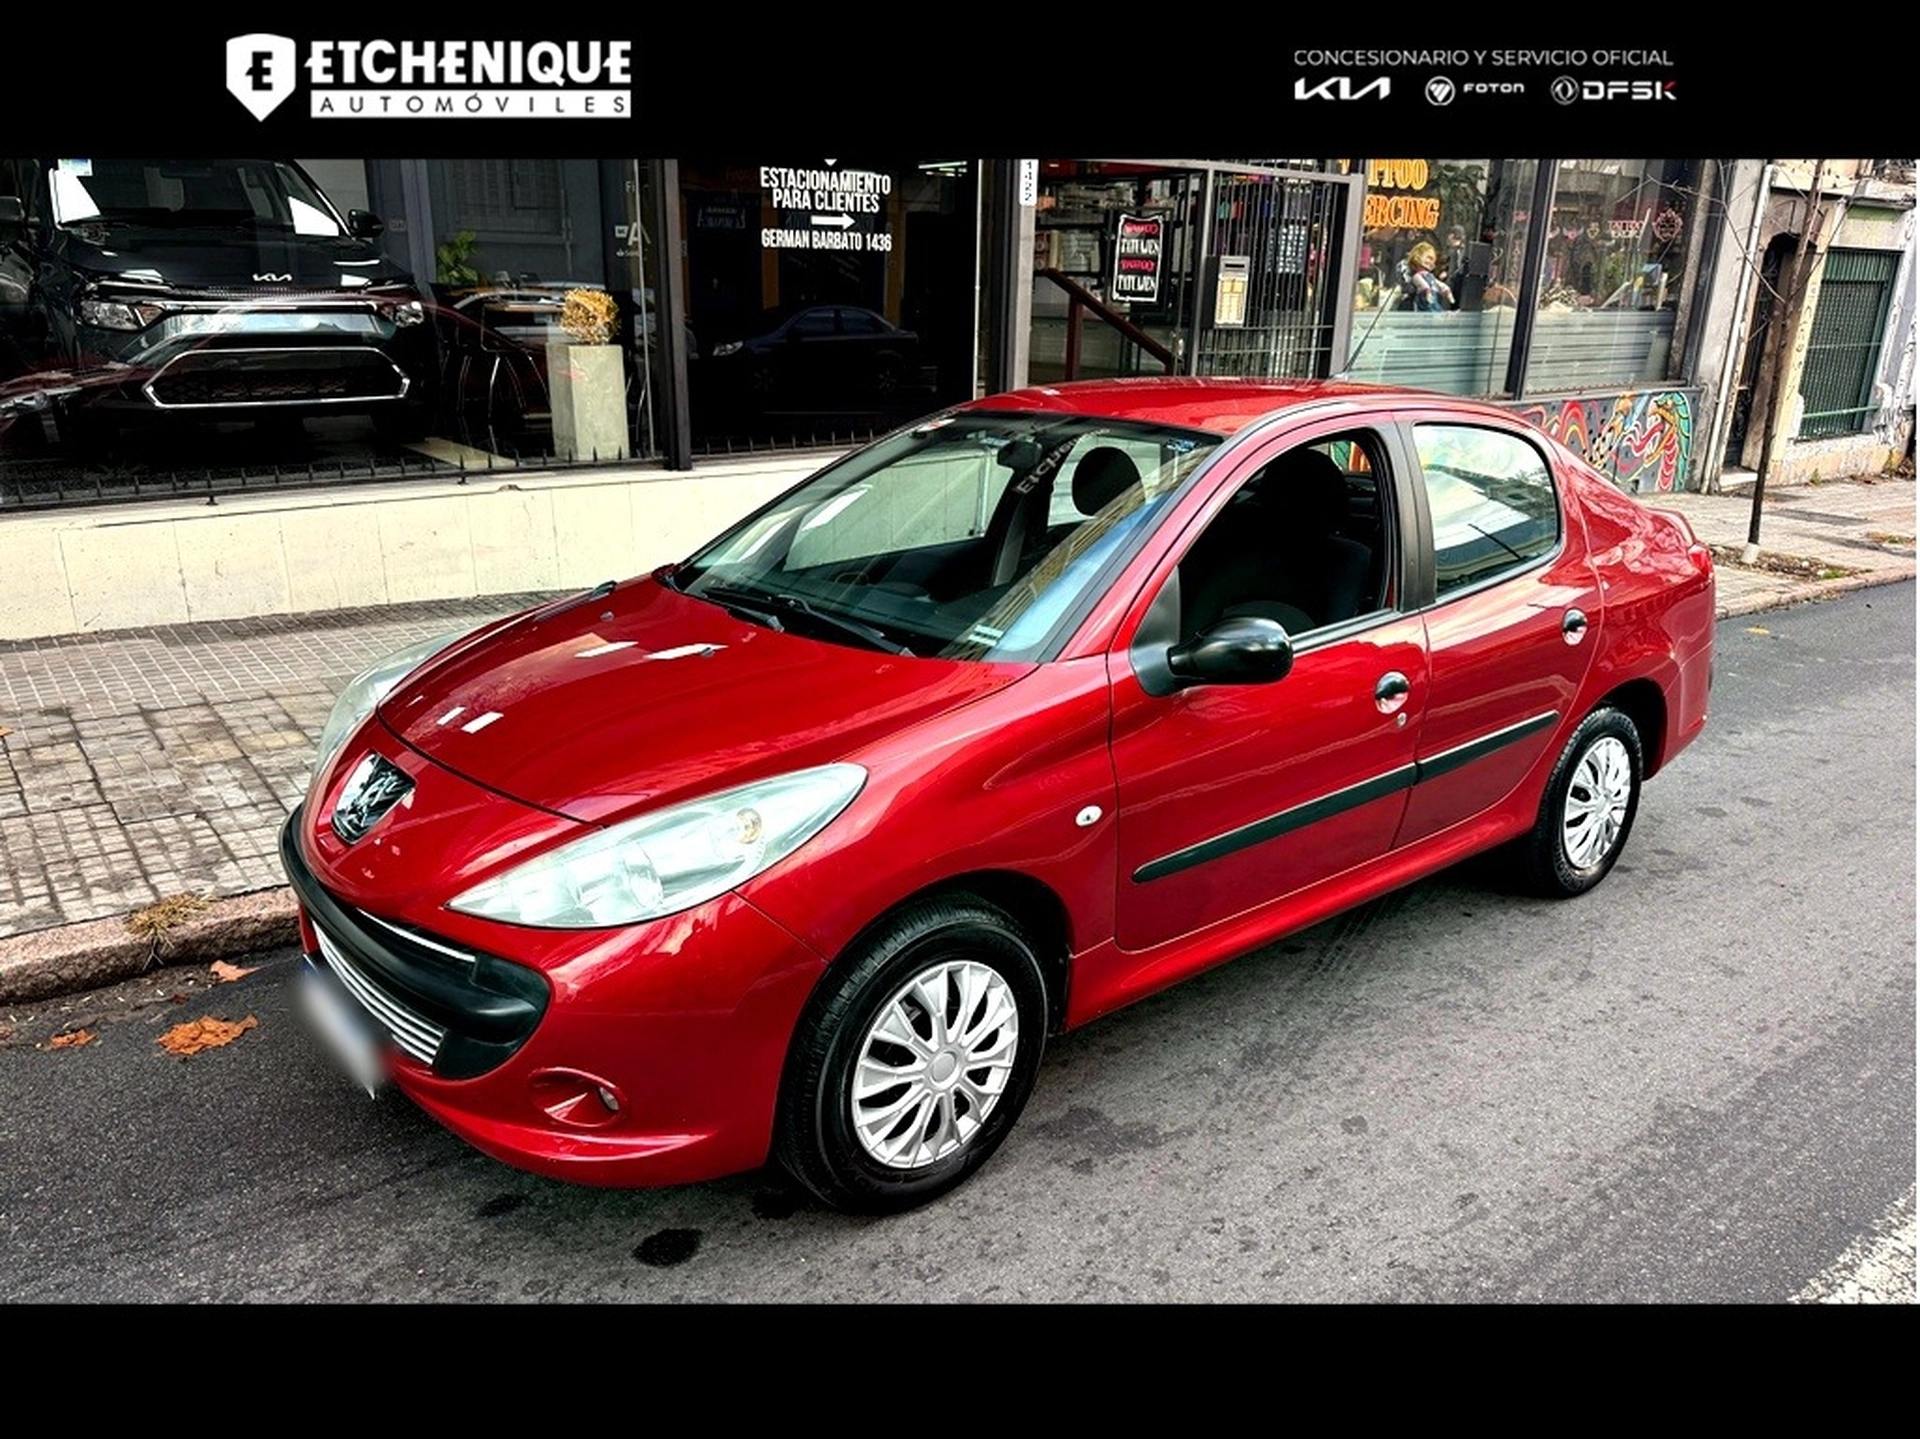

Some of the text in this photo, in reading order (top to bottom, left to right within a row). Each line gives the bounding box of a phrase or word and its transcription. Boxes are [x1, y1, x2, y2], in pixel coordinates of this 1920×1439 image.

[760, 166, 891, 195] ESTACIONAMIENTO
[772, 188, 880, 214] PARA CLIENTES
[761, 228, 810, 249] GERMAN
[812, 230, 863, 251] BARBATO
[252, 272, 293, 282] KIA
